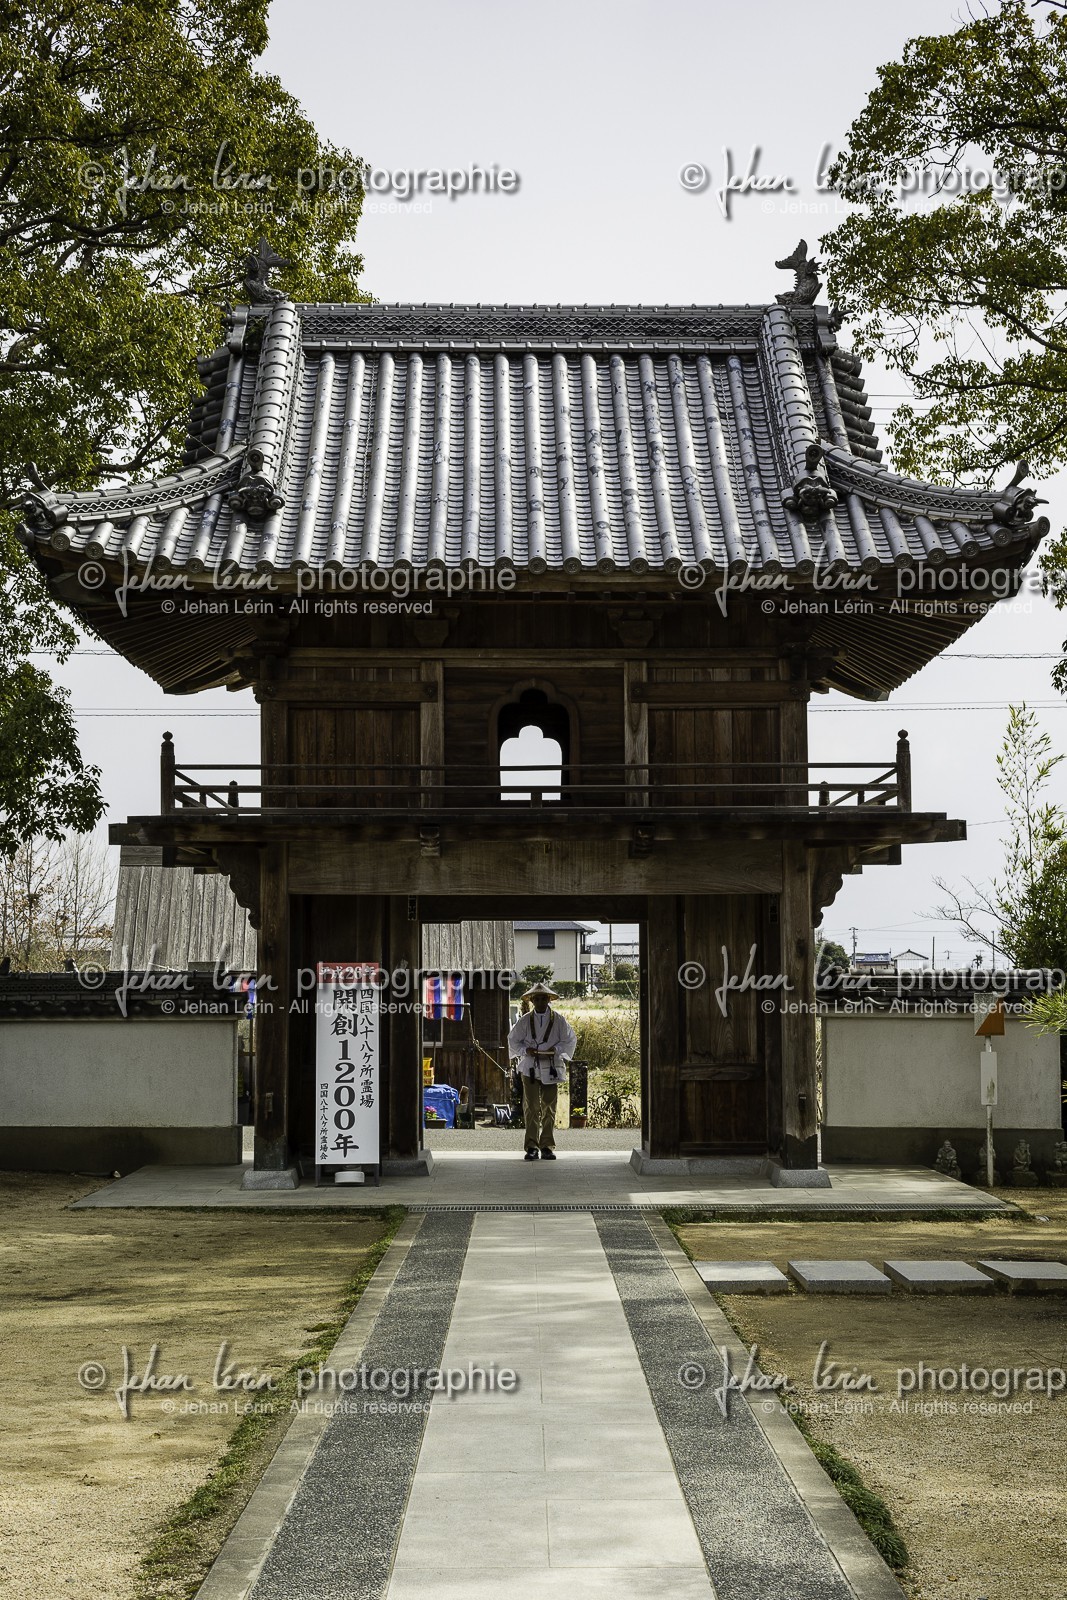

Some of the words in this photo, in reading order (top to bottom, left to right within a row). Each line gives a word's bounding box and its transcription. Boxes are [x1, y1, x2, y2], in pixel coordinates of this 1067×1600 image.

[318, 966, 377, 980] 平成26年
[330, 988, 360, 1158] 開創1200年
